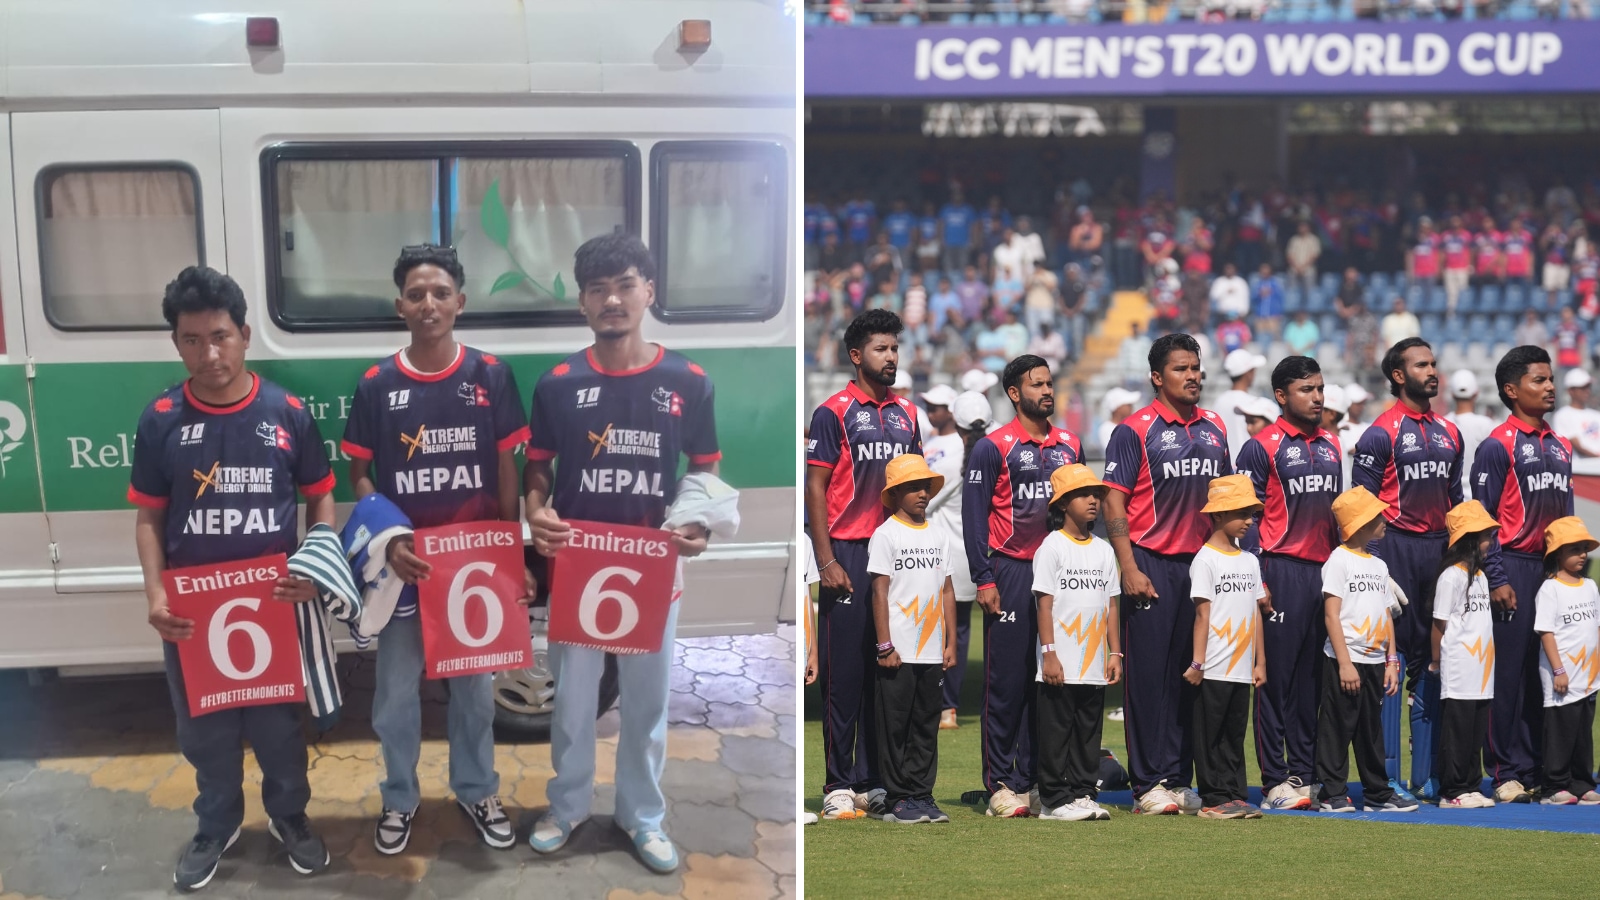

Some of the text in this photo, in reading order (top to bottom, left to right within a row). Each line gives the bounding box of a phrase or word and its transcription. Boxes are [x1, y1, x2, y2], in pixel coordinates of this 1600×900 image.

[914, 31, 1562, 81] ICC MEN'S T20 WORLD CUP
[421, 426, 476, 445] XTREME
[607, 428, 661, 448] XTREME
[422, 442, 476, 454] ENERGY DRINK
[214, 467, 273, 484] XTREME
[395, 464, 483, 494] NEPAL
[1162, 457, 1221, 479] NEPAL
[214, 483, 272, 494] ENERGY DRINK
[579, 469, 664, 497] NEPAL
[183, 508, 281, 535] NEPAL
[424, 529, 515, 555] Emirates
[568, 528, 668, 558] Emirates
[901, 547, 941, 556] MARRIOTT
[894, 557, 943, 571] BONVO
[1066, 568, 1104, 576] MARRIOTT
[173, 566, 279, 594] Emirates
[1060, 577, 1109, 592] BONVOY
[447, 561, 504, 648] 6
[578, 566, 643, 640] 6
[999, 611, 1016, 623] 24
[1269, 610, 1285, 623] 21
[208, 597, 272, 681] 6
[436, 650, 524, 673] #FLYBETTERMOMENTS
[200, 683, 295, 708] #FLYBETTERMOMENTS
